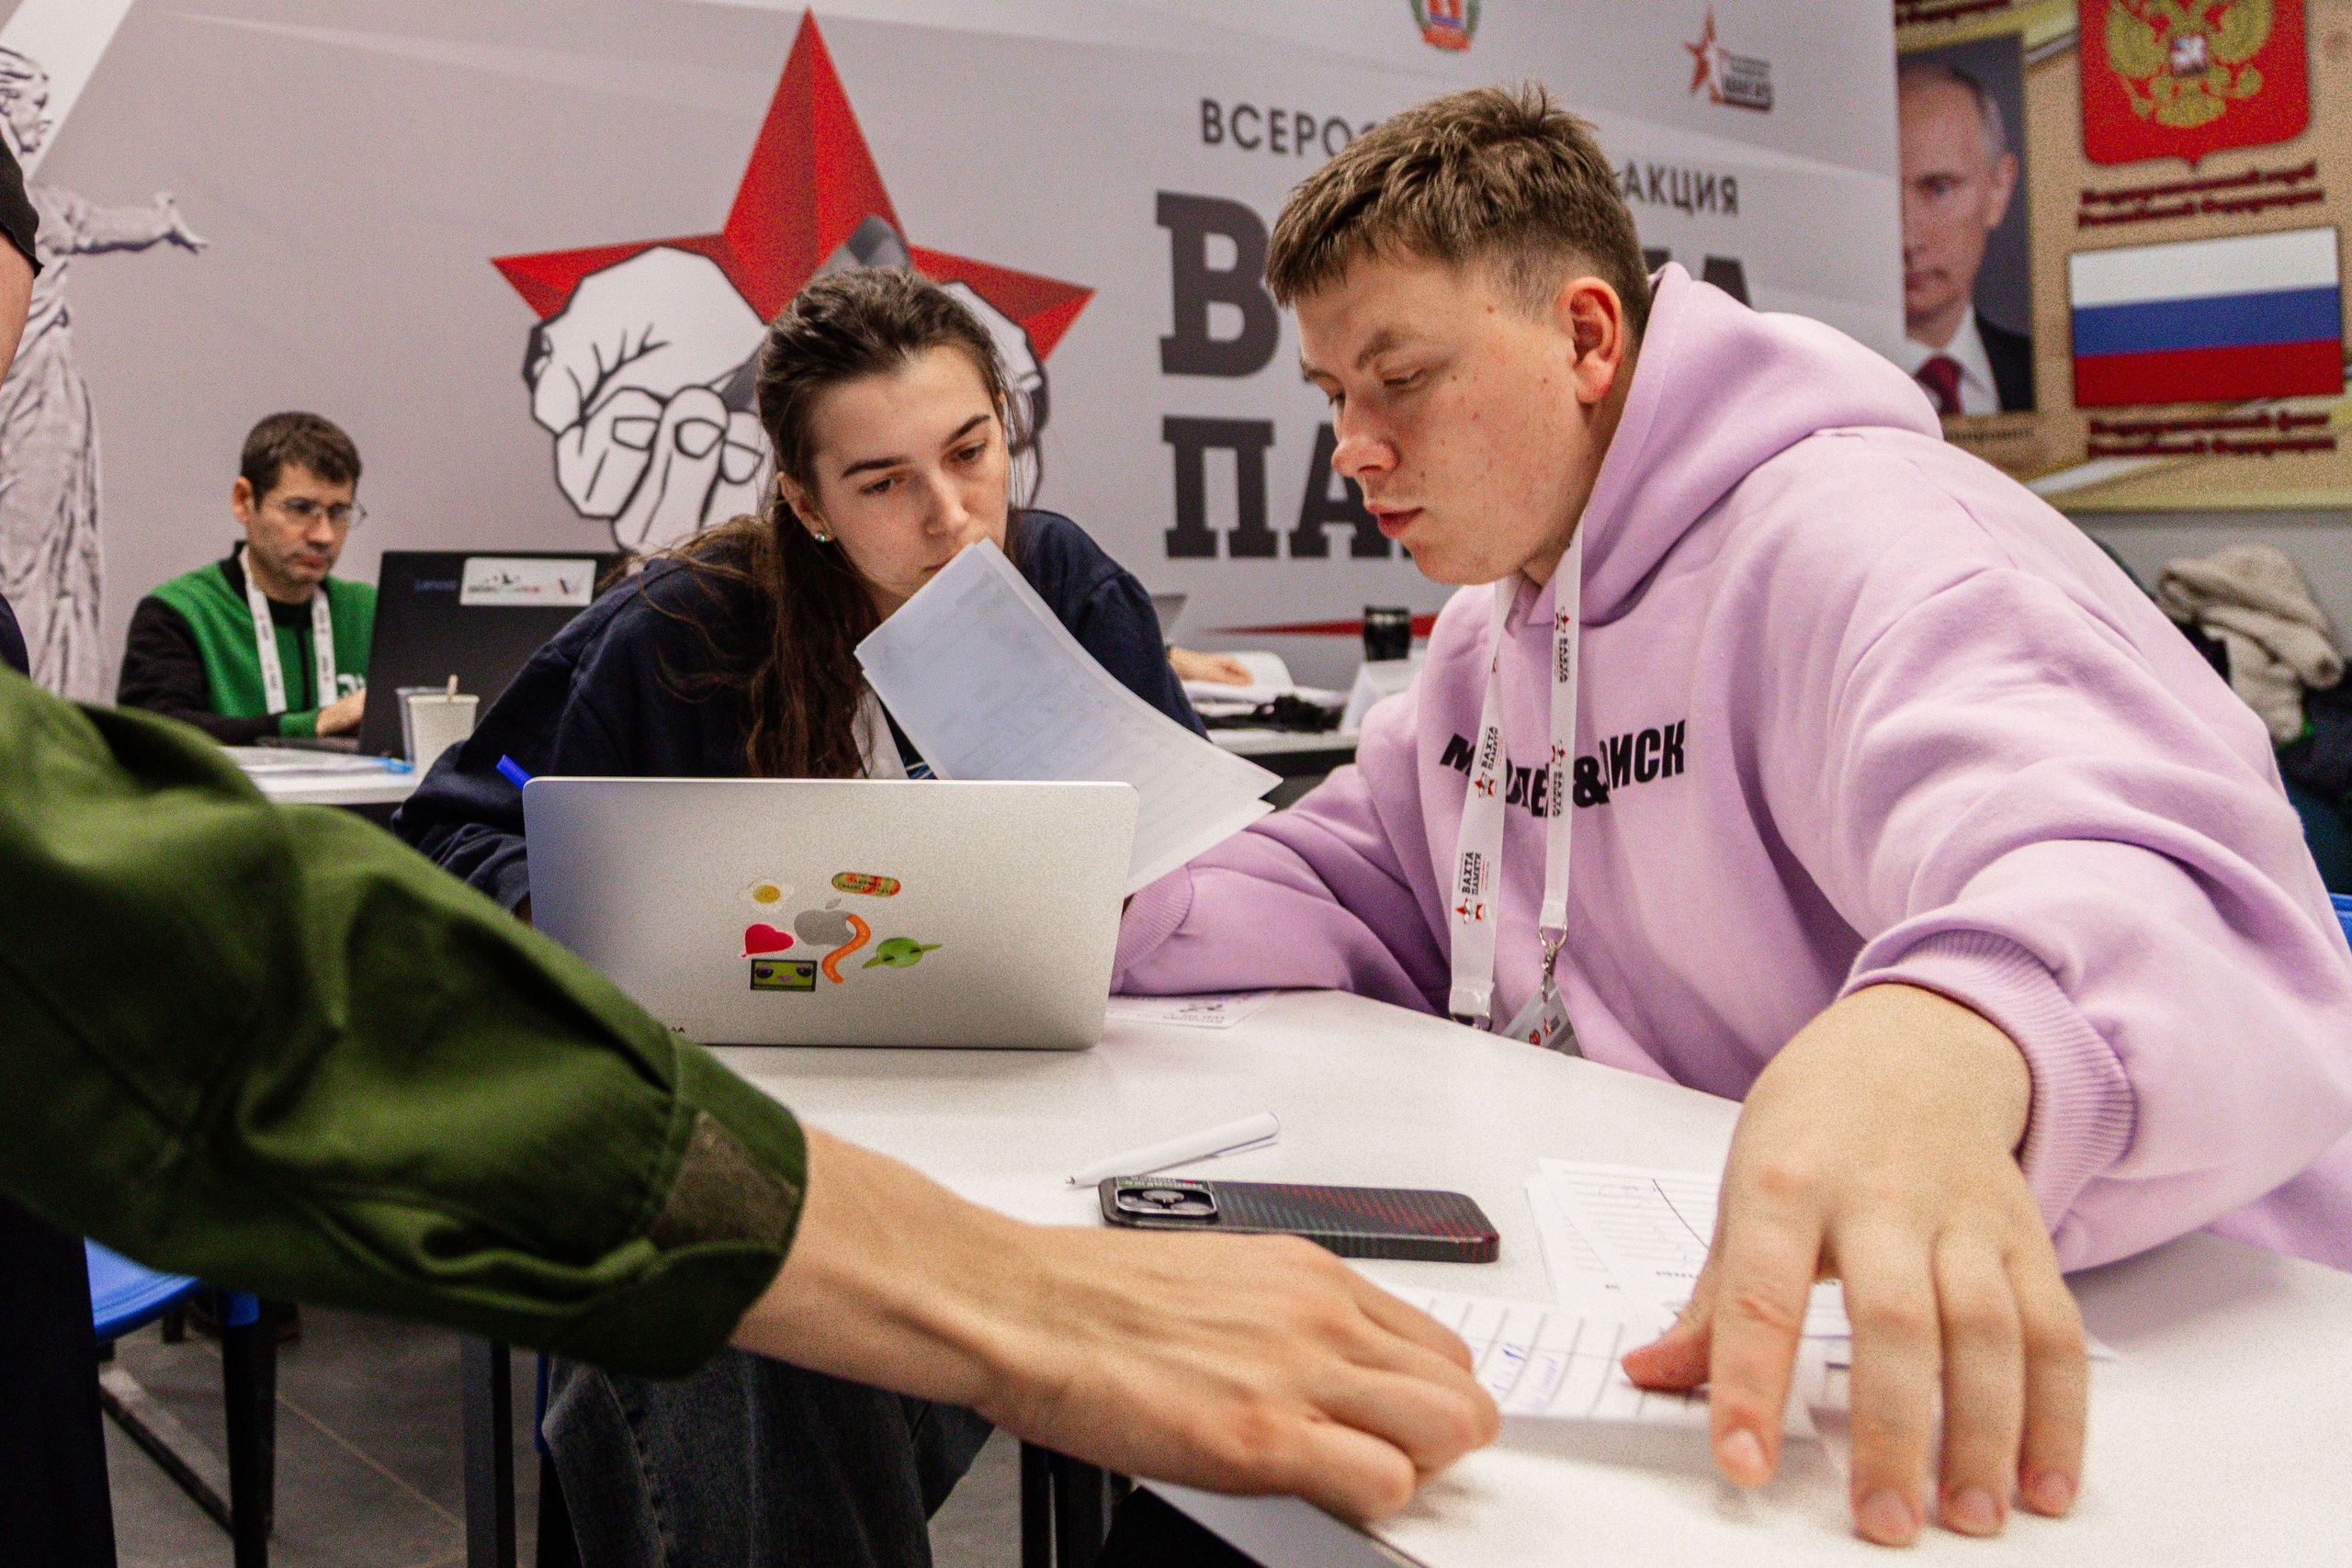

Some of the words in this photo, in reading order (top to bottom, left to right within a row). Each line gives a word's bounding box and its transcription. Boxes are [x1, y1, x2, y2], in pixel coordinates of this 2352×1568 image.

[1624, 161, 1739, 217] АКЦИЯ
[1480, 726, 1495, 768] ВАХТА
[1461, 851, 1475, 894] ВАХТА
